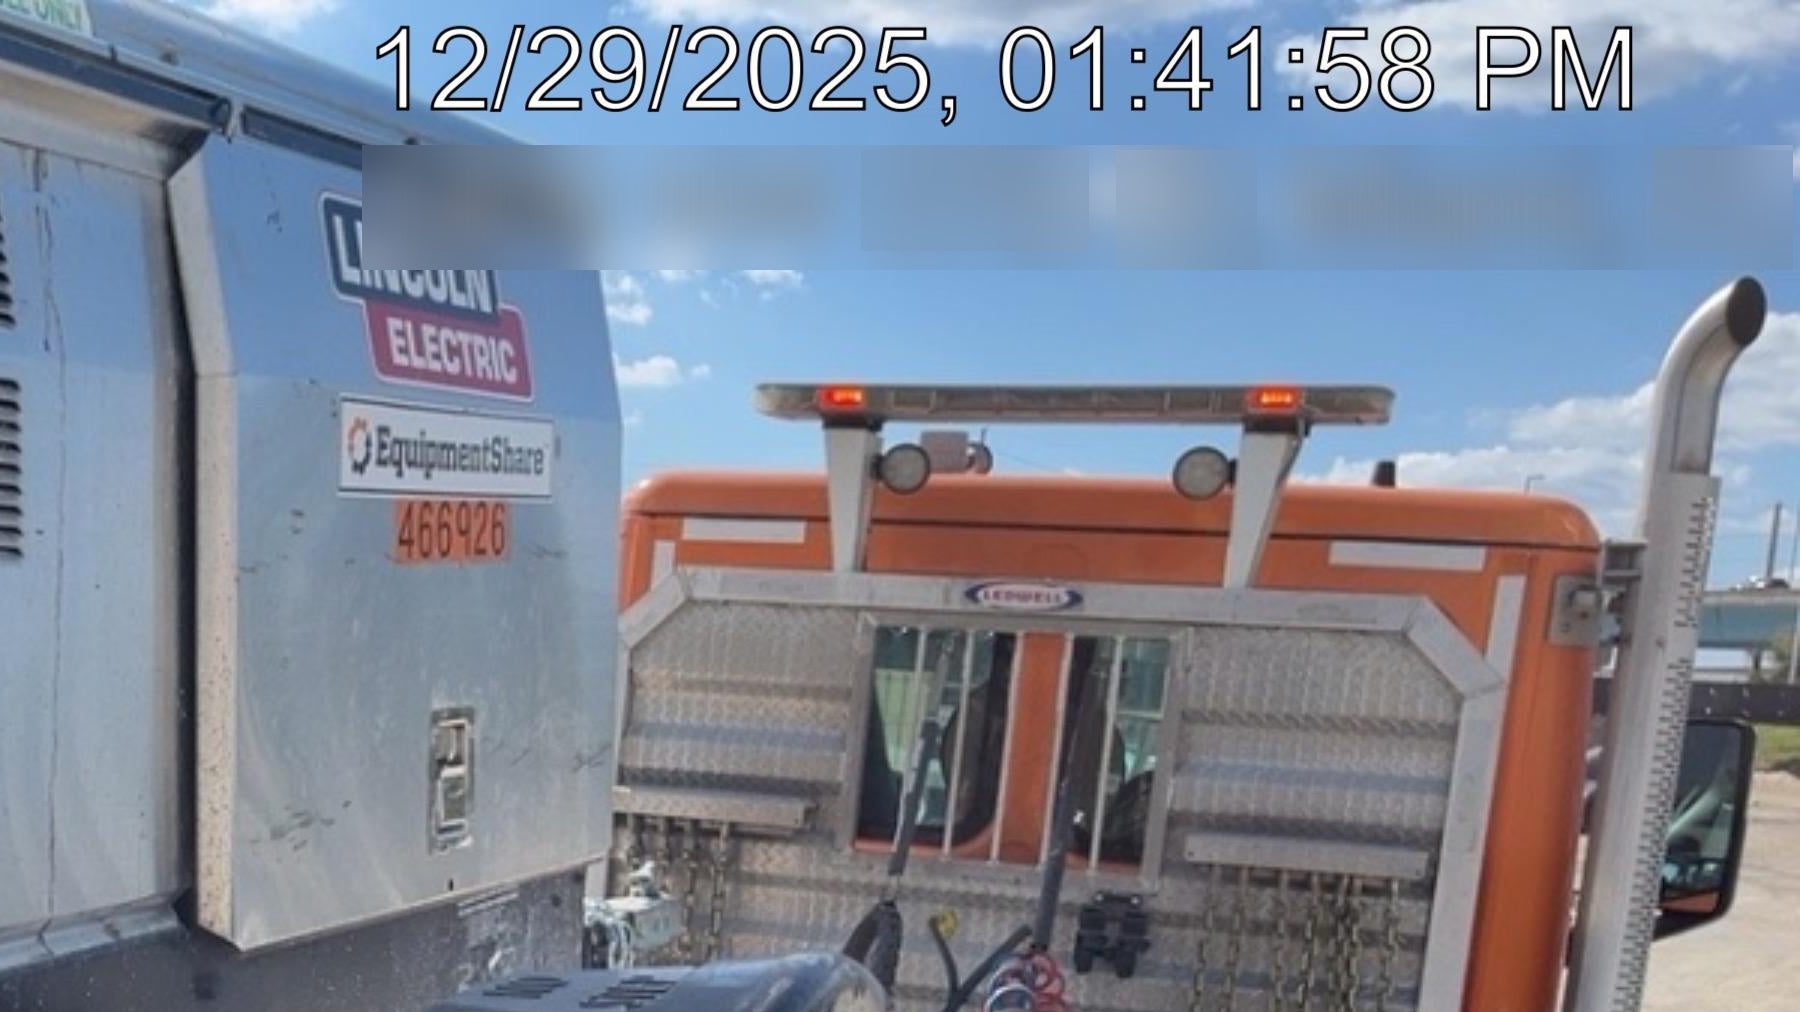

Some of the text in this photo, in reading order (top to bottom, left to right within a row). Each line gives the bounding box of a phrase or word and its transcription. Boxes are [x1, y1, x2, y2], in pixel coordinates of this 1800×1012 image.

[333, 214, 494, 313] LOLN
[387, 316, 518, 384] ELECTRIC
[375, 424, 544, 480] EquipmentShare
[398, 501, 506, 559] 466926
